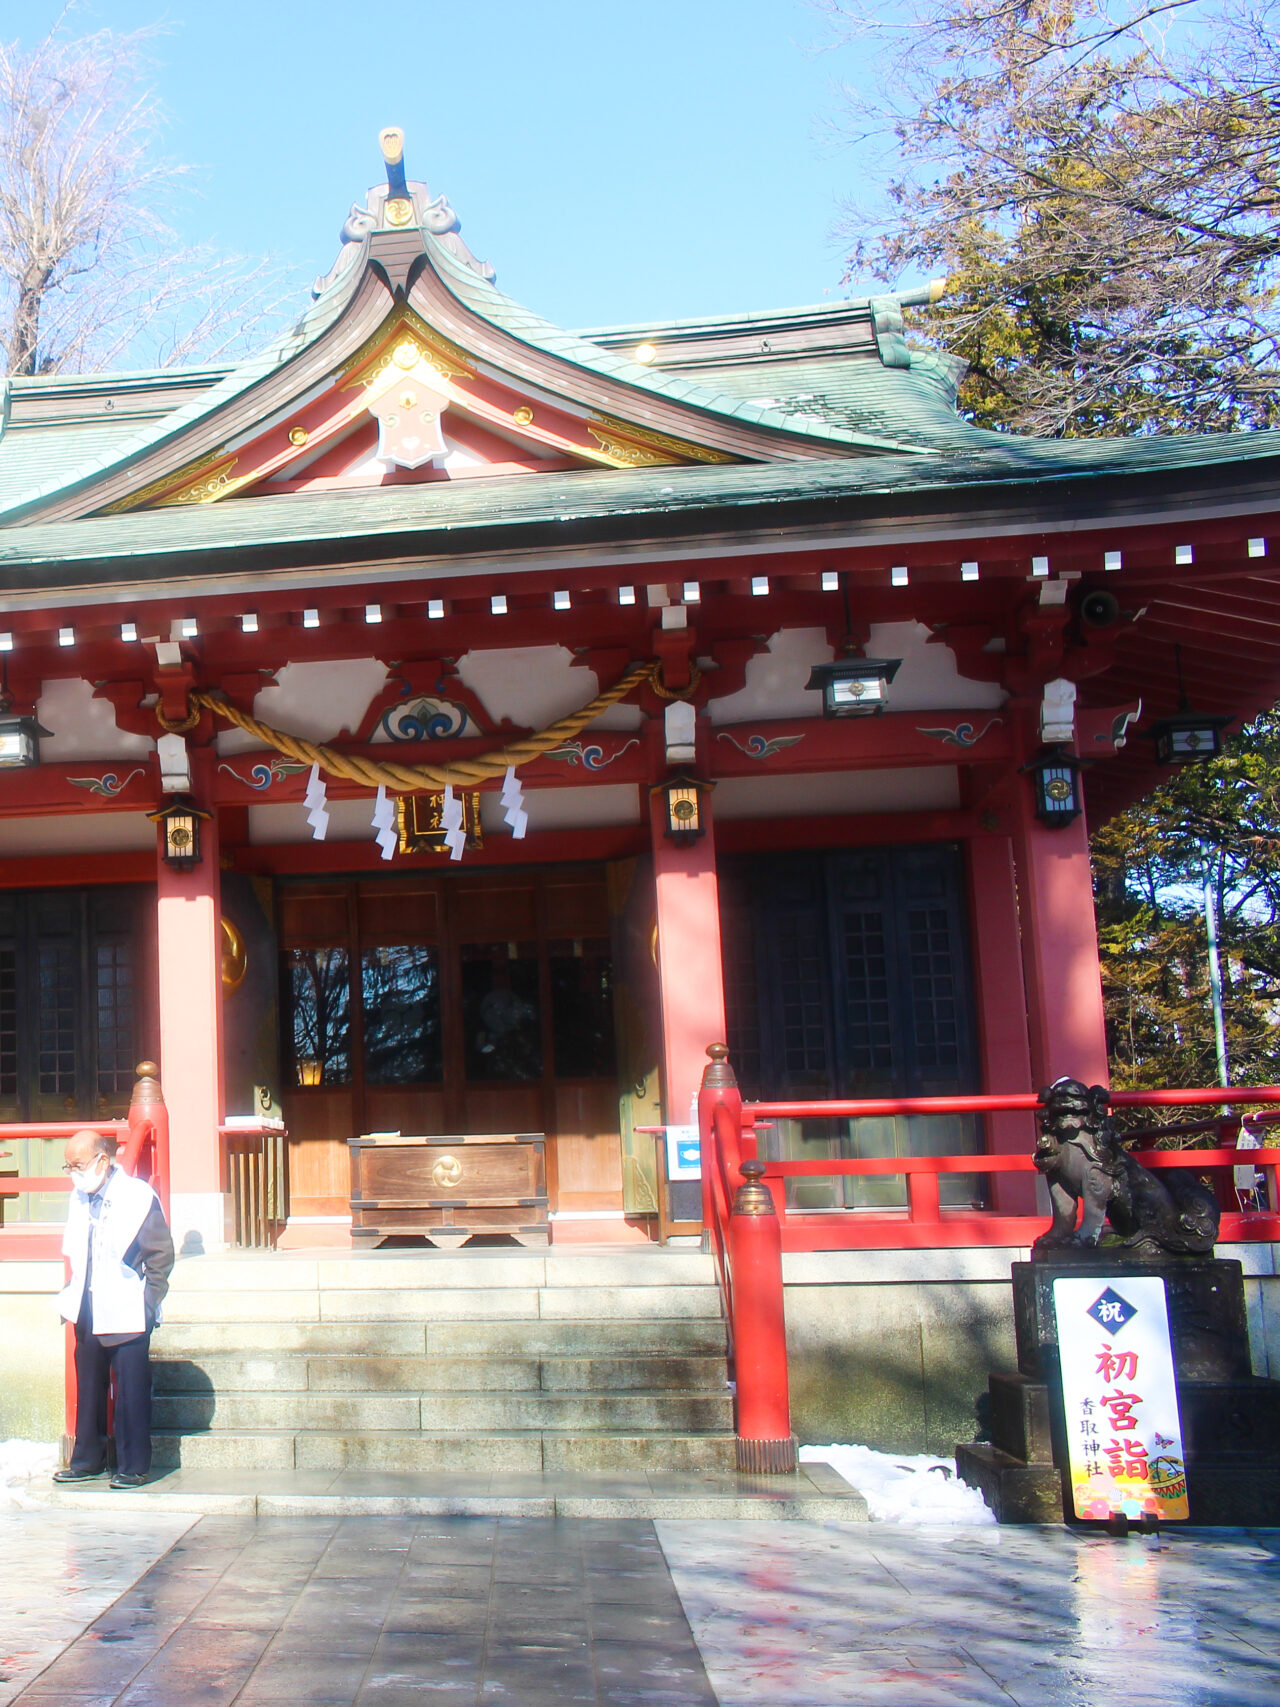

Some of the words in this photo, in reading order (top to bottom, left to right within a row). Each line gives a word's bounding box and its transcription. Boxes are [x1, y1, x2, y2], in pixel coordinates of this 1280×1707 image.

[1097, 1299, 1125, 1323] 祝
[1079, 1397, 1104, 1478] 香取神社
[1095, 1343, 1149, 1481] 初宮詣
